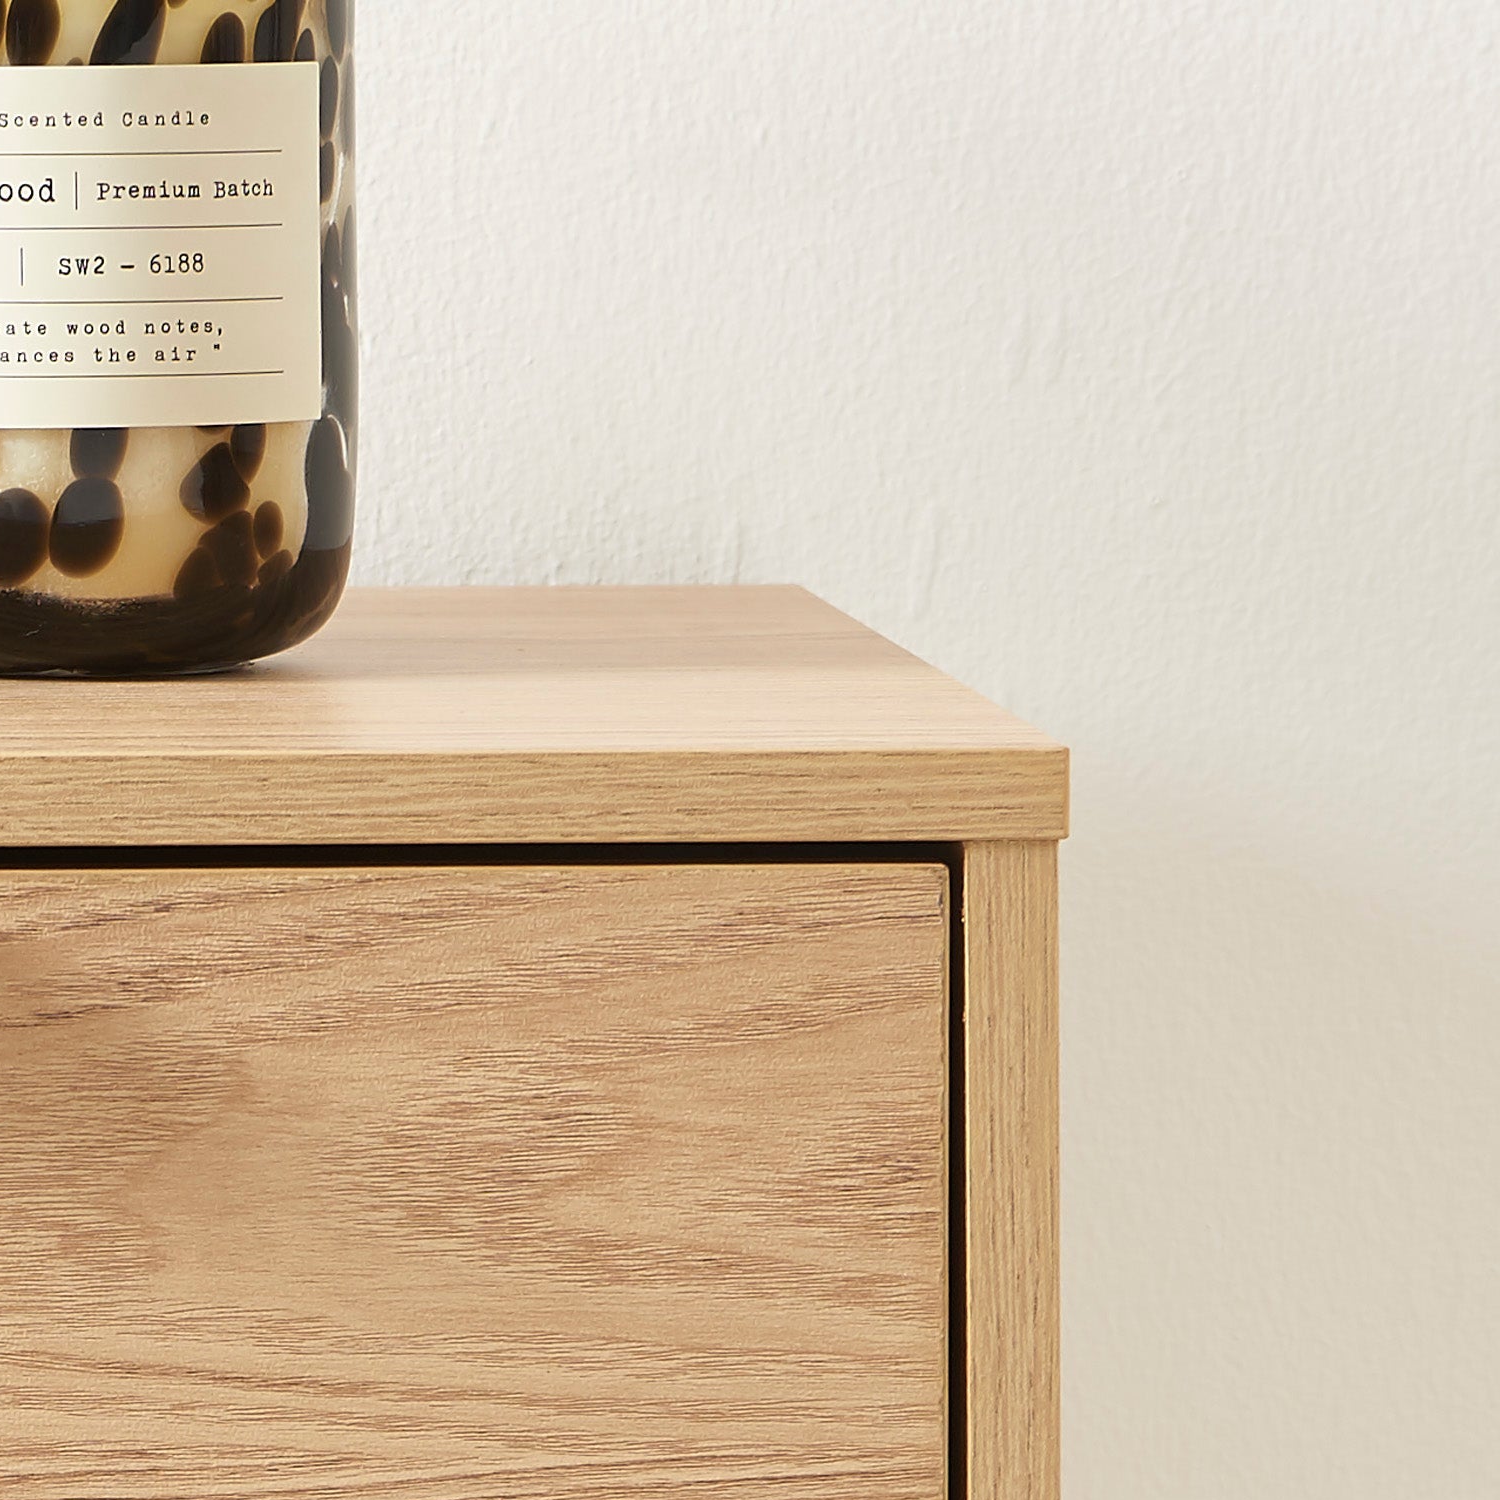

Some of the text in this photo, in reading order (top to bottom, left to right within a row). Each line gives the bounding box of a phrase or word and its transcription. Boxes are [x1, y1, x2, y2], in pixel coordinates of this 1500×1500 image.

[122, 110, 210, 128] Candle
[96, 178, 273, 201] Premium Batch
[58, 255, 105, 276] SW2
[149, 252, 204, 274] 6188
[66, 319, 126, 335] wood
[144, 318, 223, 337] notes,
[94, 347, 136, 363] the
[154, 346, 197, 362] air
